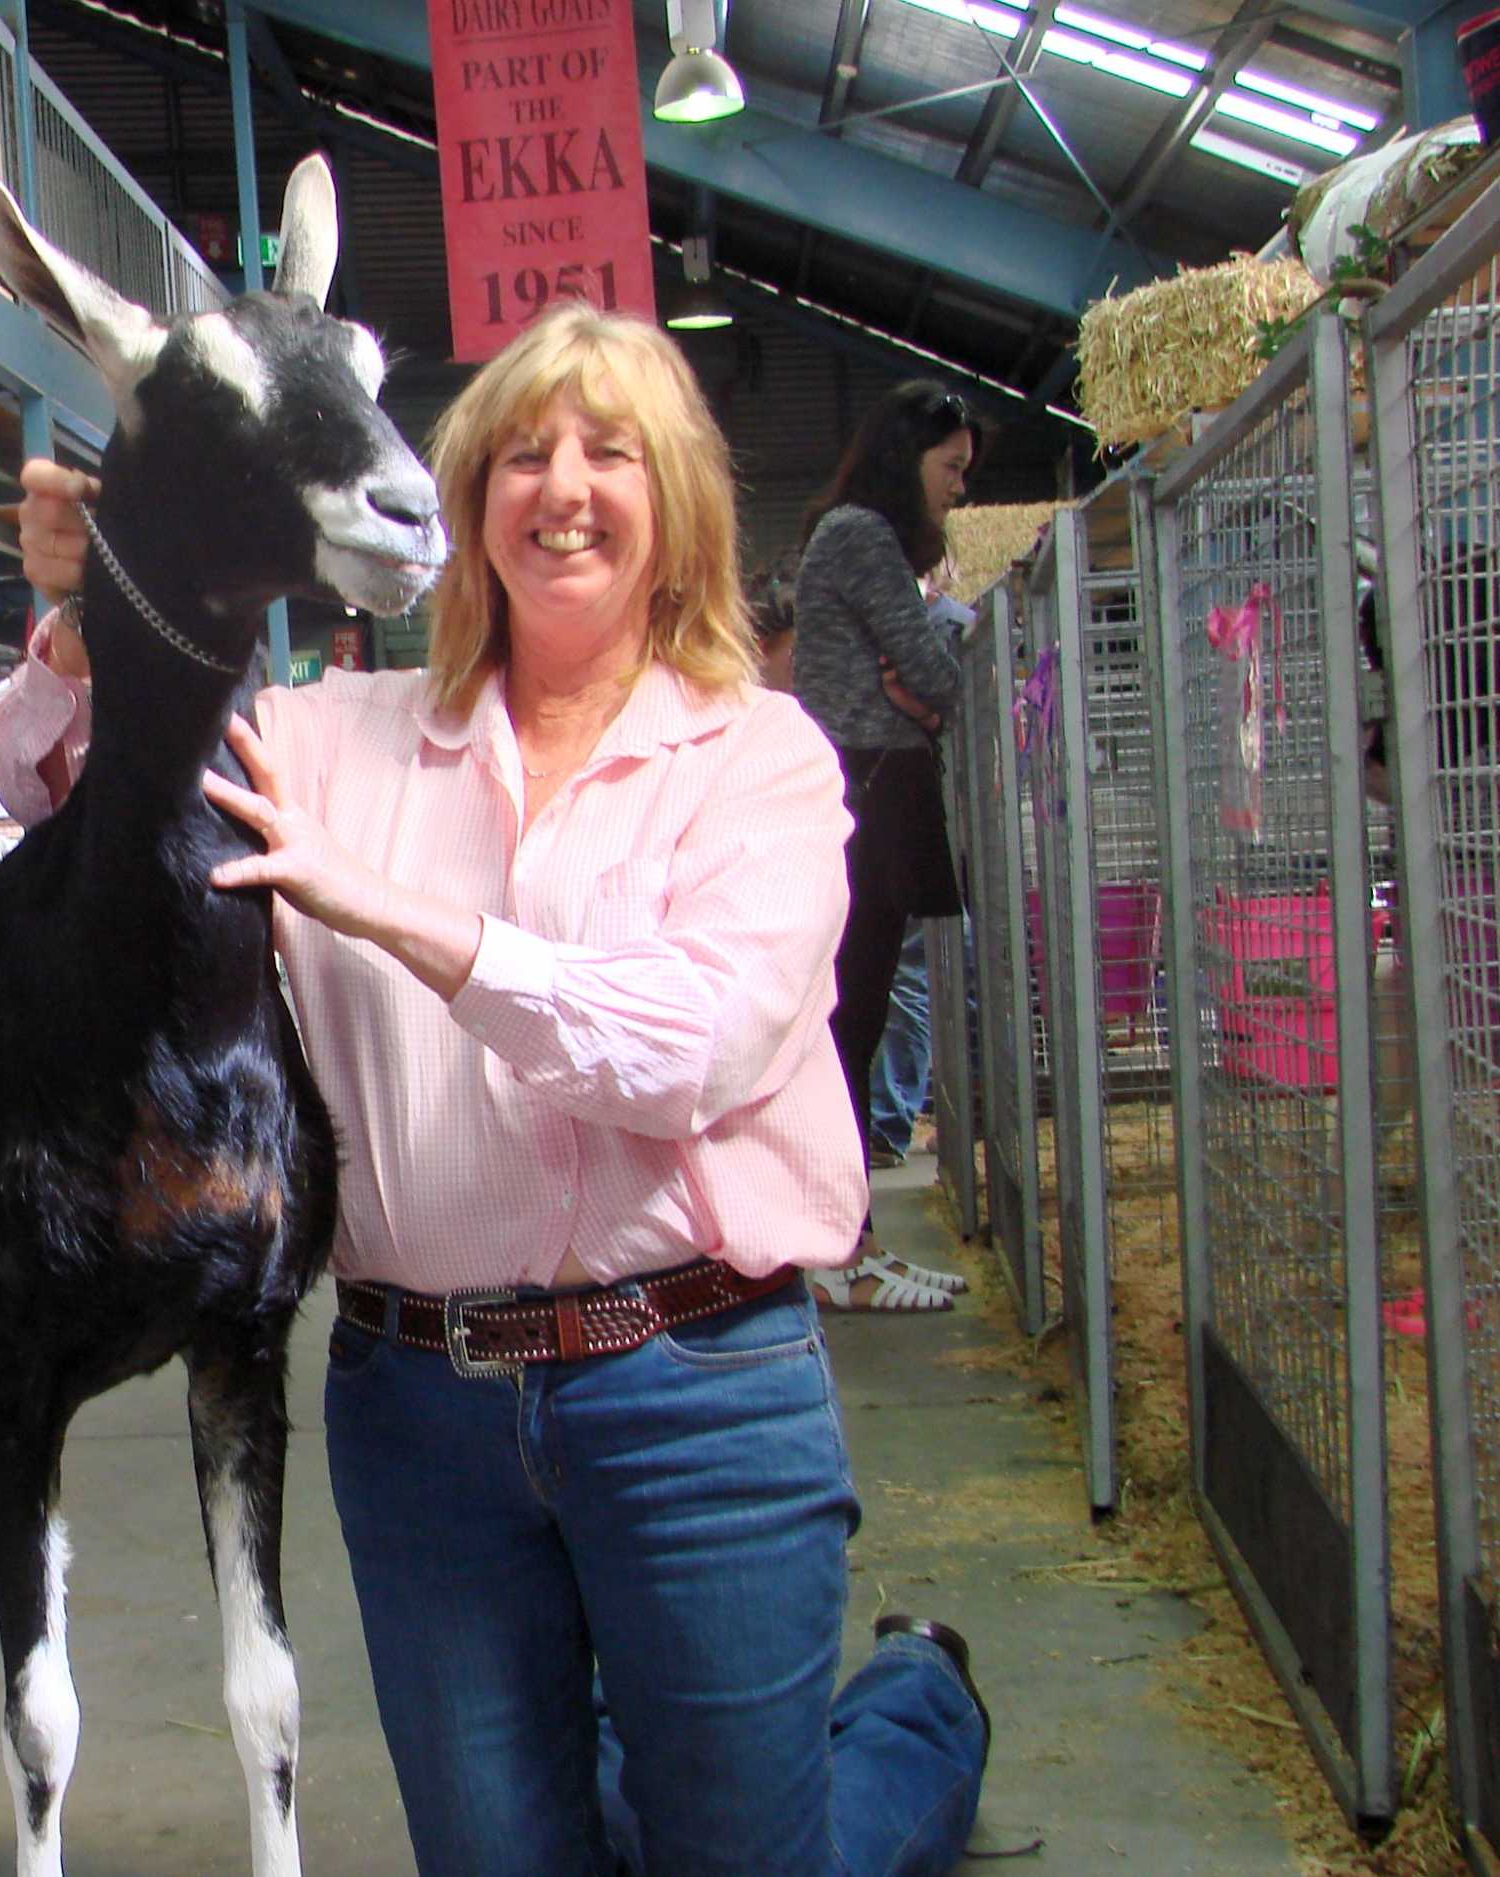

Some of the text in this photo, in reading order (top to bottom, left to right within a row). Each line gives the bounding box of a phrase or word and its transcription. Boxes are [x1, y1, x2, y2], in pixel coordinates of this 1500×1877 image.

[461, 47, 612, 90] PART OF
[509, 96, 564, 124] THE
[455, 127, 625, 203] EKKA
[501, 216, 586, 247] SINCE
[479, 260, 622, 325] 1951
[288, 661, 310, 681] XIT
